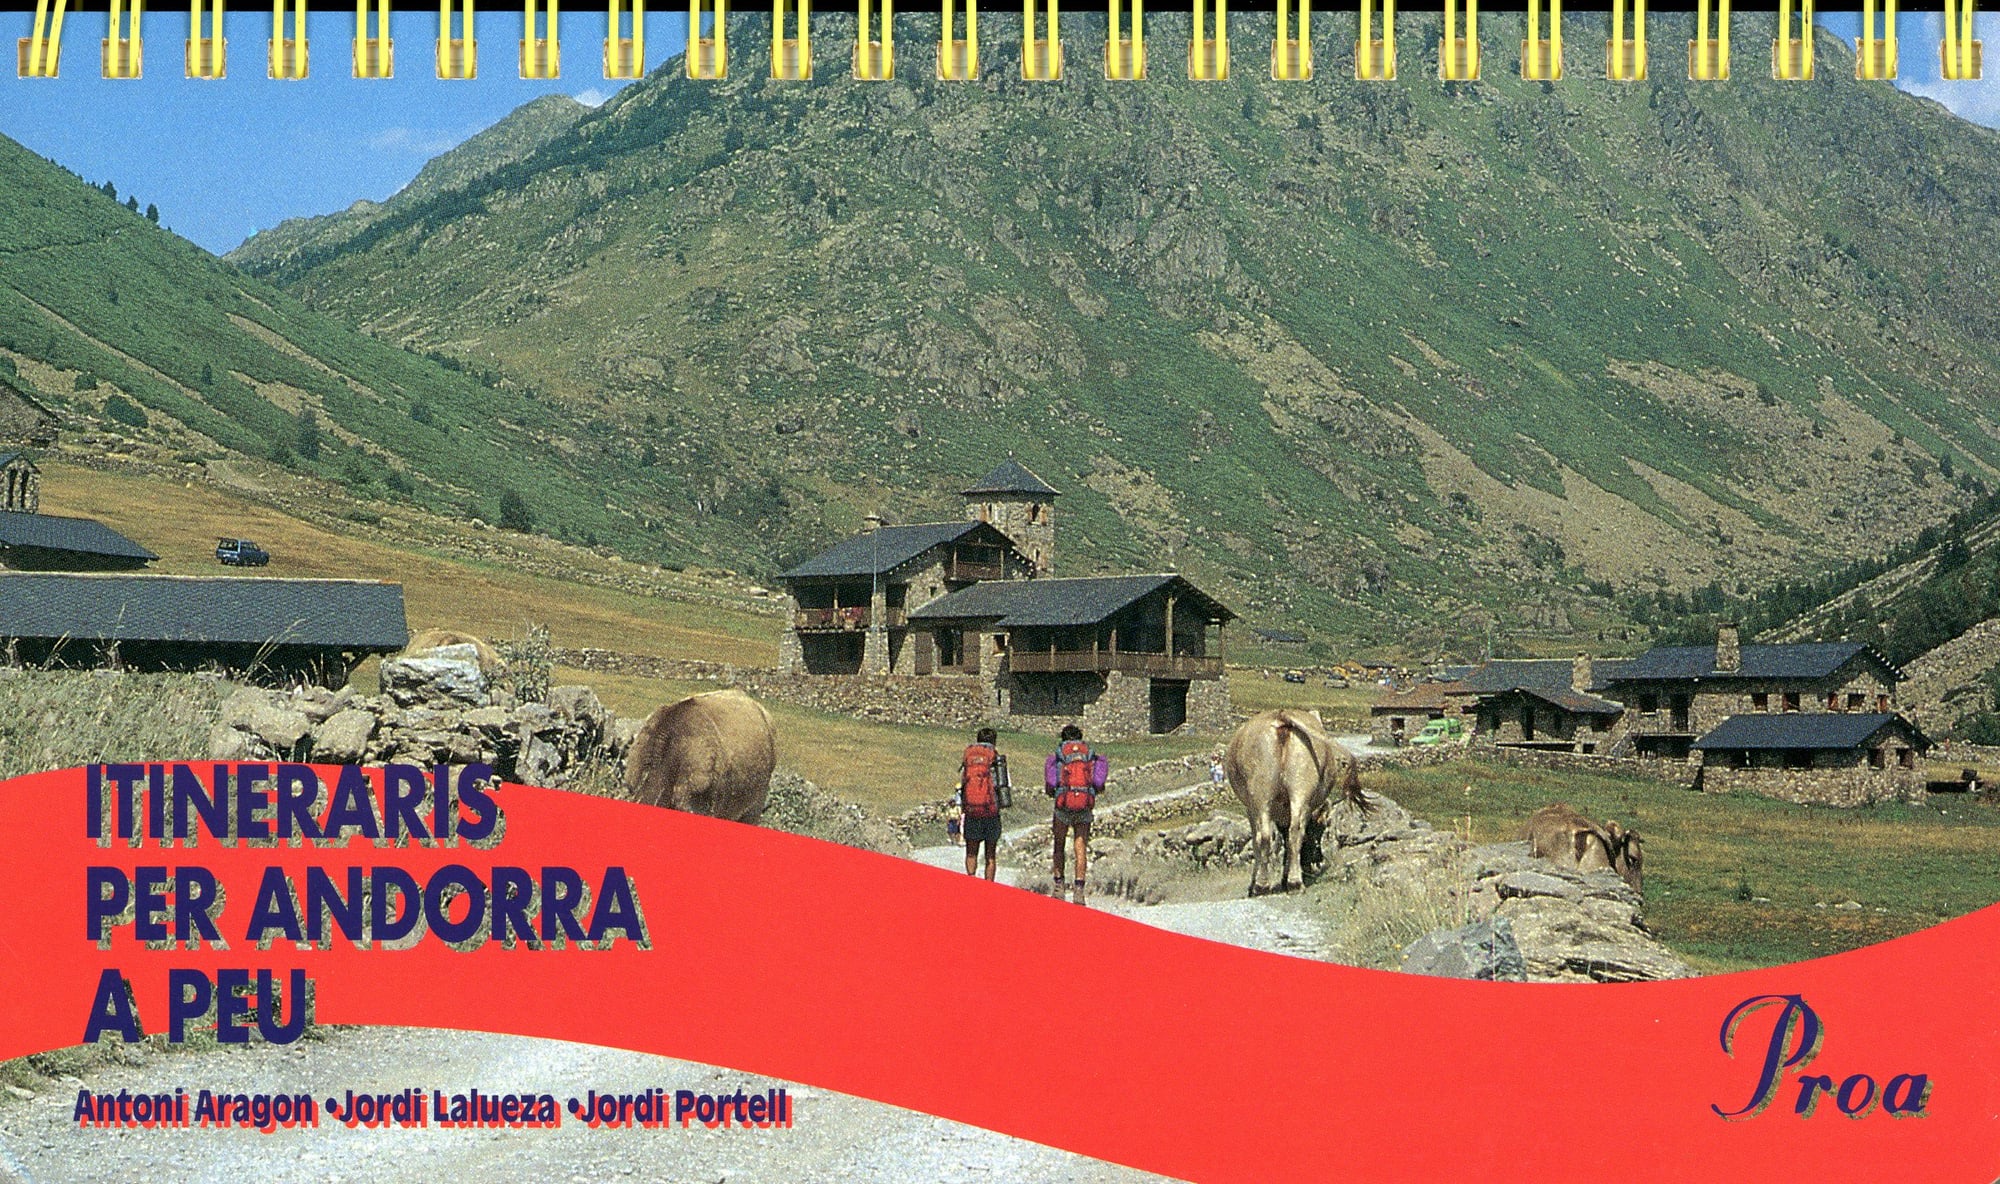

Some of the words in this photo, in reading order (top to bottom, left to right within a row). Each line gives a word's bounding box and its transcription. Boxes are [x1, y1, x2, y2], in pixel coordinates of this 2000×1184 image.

[86, 763, 498, 841] ITINERARIS
[87, 867, 220, 941] PER
[246, 864, 643, 943] ANDORRA
[83, 969, 140, 1044] A
[169, 969, 307, 1046] PEU
[1711, 993, 1928, 1116] Proa
[73, 1088, 184, 1122] Antoni
[194, 1089, 313, 1129] Aragon
[433, 1089, 556, 1123] Lalueza
[675, 1088, 789, 1123] Portell
